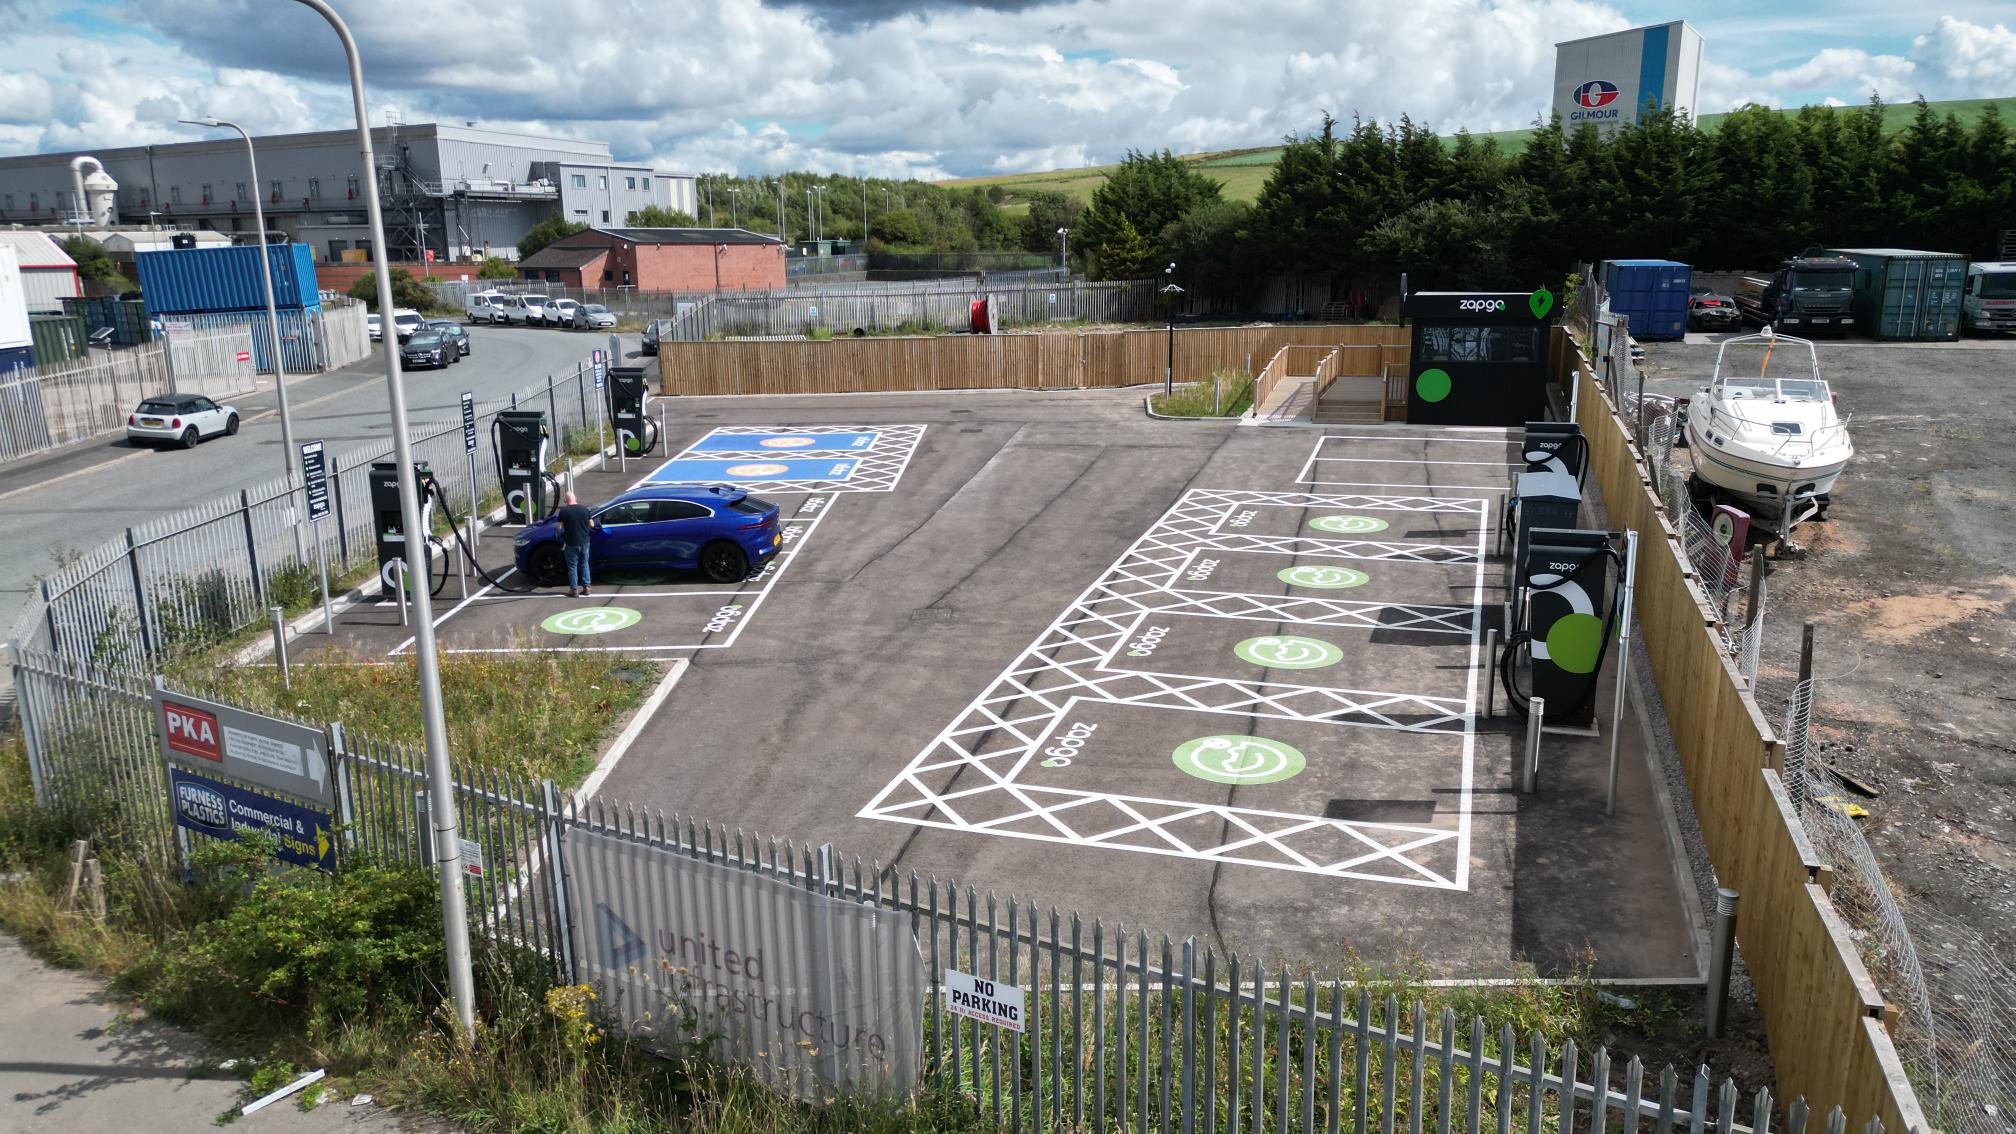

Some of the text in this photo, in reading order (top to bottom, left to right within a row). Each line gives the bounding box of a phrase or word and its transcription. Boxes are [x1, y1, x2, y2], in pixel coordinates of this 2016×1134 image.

[1570, 109, 1619, 121] GILMOUR
[1459, 299, 1506, 313] zapgo
[383, 481, 400, 489] zap
[1186, 558, 1221, 581] zapgo
[1549, 562, 1580, 573] zapg
[702, 604, 743, 633] zapgo
[1127, 626, 1171, 657] zapgo
[167, 711, 216, 746] PKA
[1040, 722, 1098, 768] zapgo
[179, 786, 224, 812] FURNESS
[181, 799, 226, 825] PLASTICS
[229, 799, 305, 835] Commercial &
[231, 817, 316, 856] Indurial Signs
[658, 928, 764, 983] united
[974, 979, 994, 997] NO
[661, 955, 887, 1060] ifrastructure
[952, 989, 1018, 1021] PARKING
[968, 1010, 989, 1021] ACCESS
[991, 1016, 1021, 1030] REQUIRED
